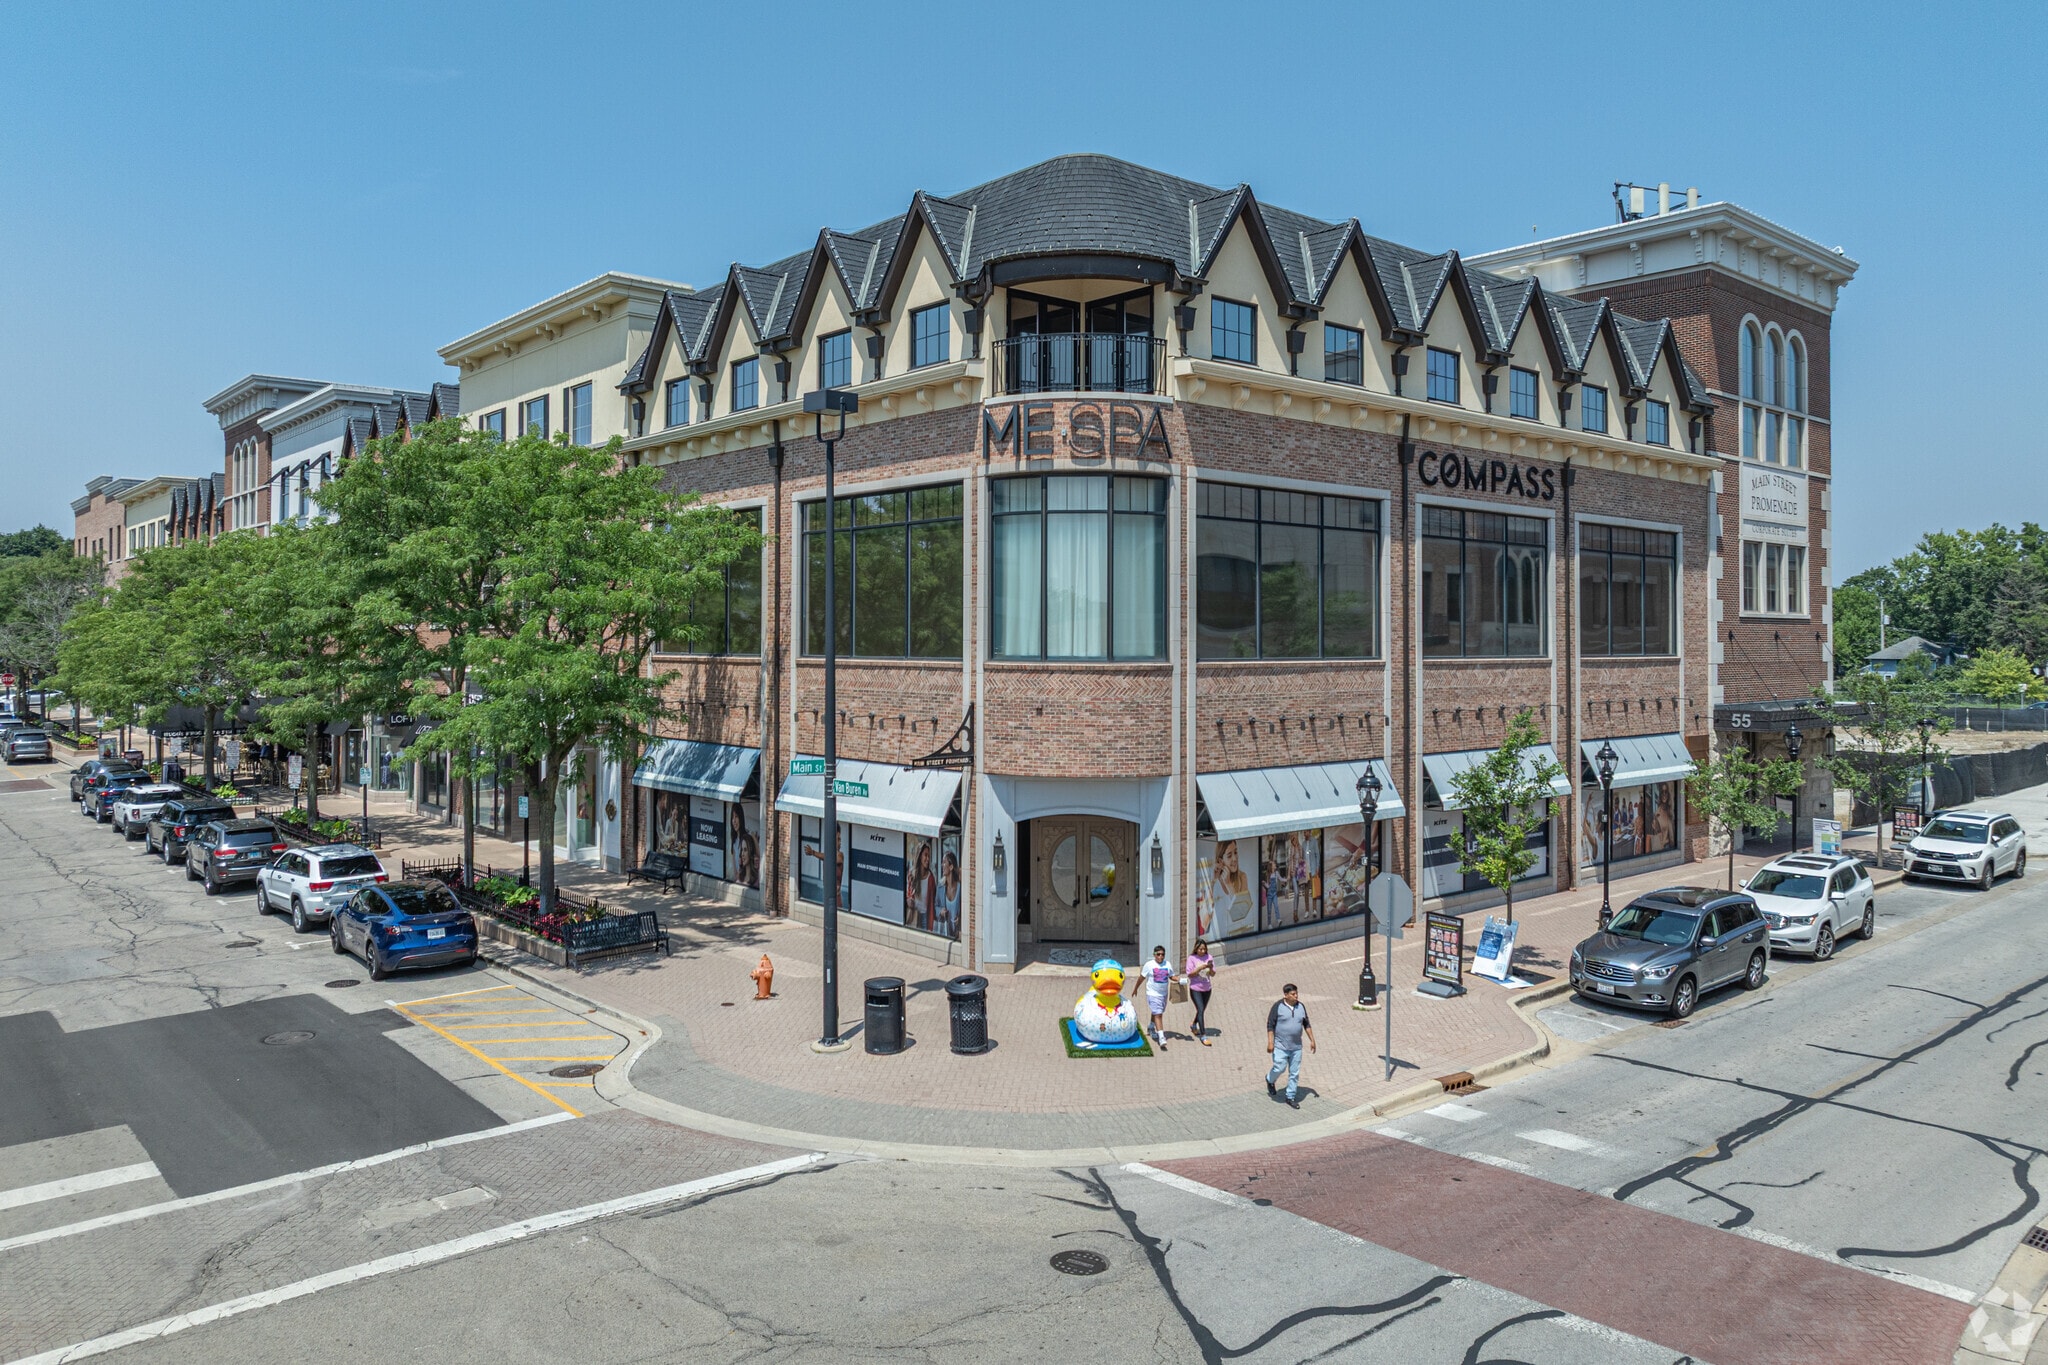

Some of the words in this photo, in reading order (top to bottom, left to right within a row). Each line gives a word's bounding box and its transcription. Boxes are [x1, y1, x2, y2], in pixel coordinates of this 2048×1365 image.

[983, 402, 1054, 460] ME
[1069, 402, 1173, 459] SPA
[1418, 450, 1555, 501] COMPASS
[1751, 474, 1771, 491] MAIN
[1772, 474, 1798, 498] STREET
[1751, 495, 1798, 516] PROMENADE
[1731, 713, 1752, 728] 55
[792, 761, 813, 773] Main
[815, 764, 822, 772] St
[834, 781, 845, 793] Van
[845, 782, 862, 796] Buren
[700, 823, 714, 834] NOW
[696, 831, 718, 844] LEASING
[866, 864, 878, 872] STREET
[878, 866, 900, 877] PROMENADE
